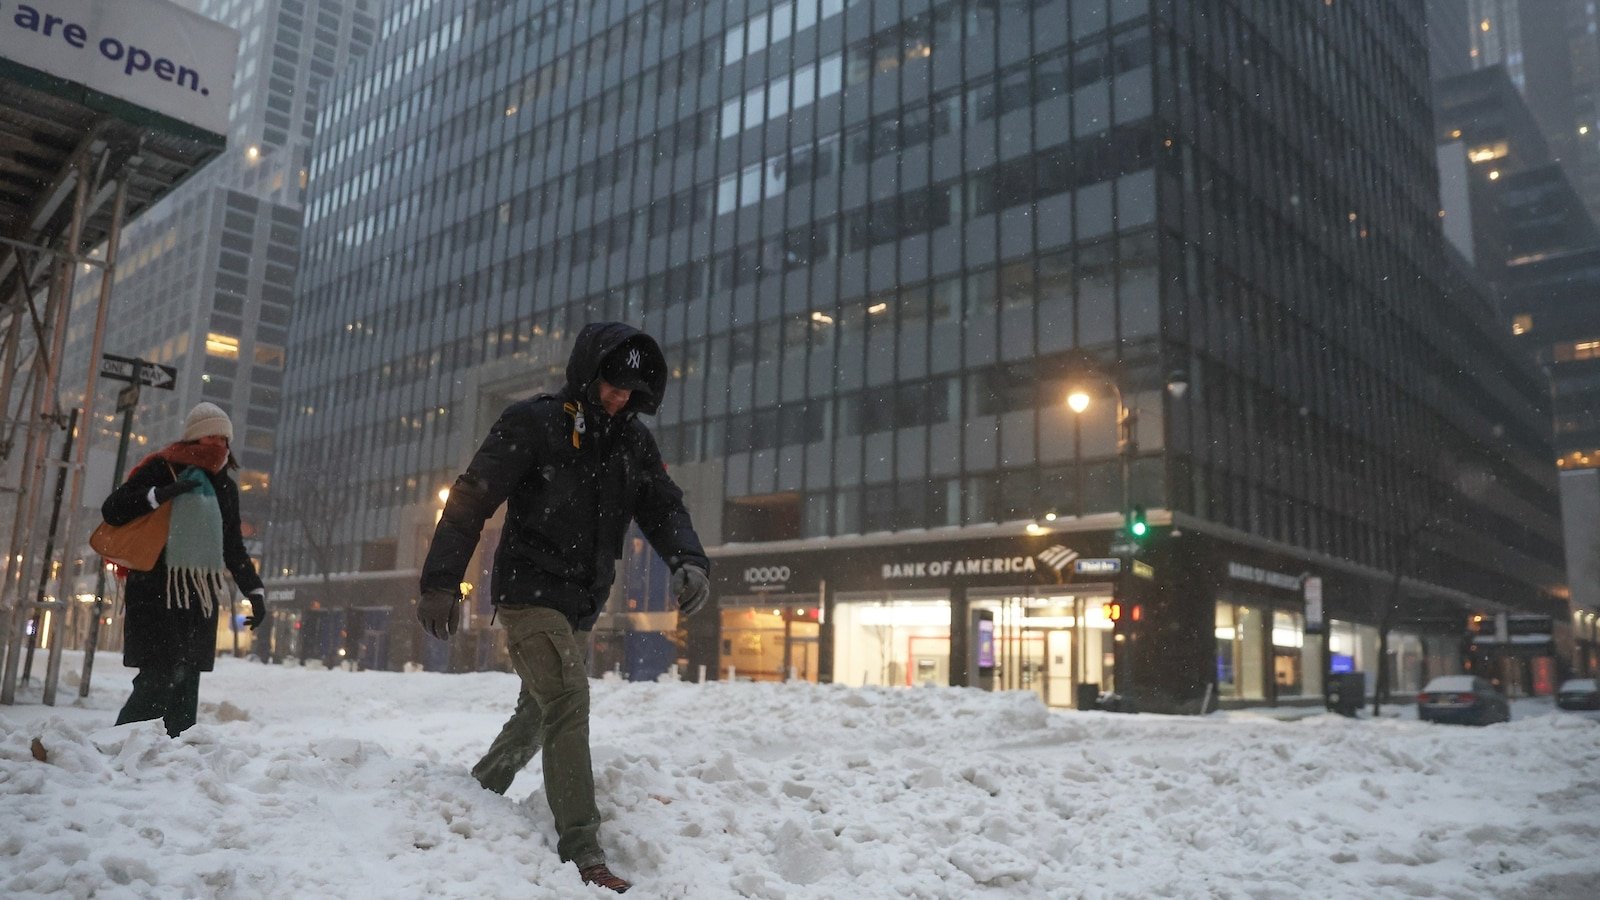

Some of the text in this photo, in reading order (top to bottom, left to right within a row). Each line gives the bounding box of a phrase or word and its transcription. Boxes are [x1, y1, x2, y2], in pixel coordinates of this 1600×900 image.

[13, 4, 210, 97] are open.
[627, 348, 641, 369] NY
[104, 359, 162, 382] ONE WAY
[881, 555, 1036, 579] BANK OF AMERICA
